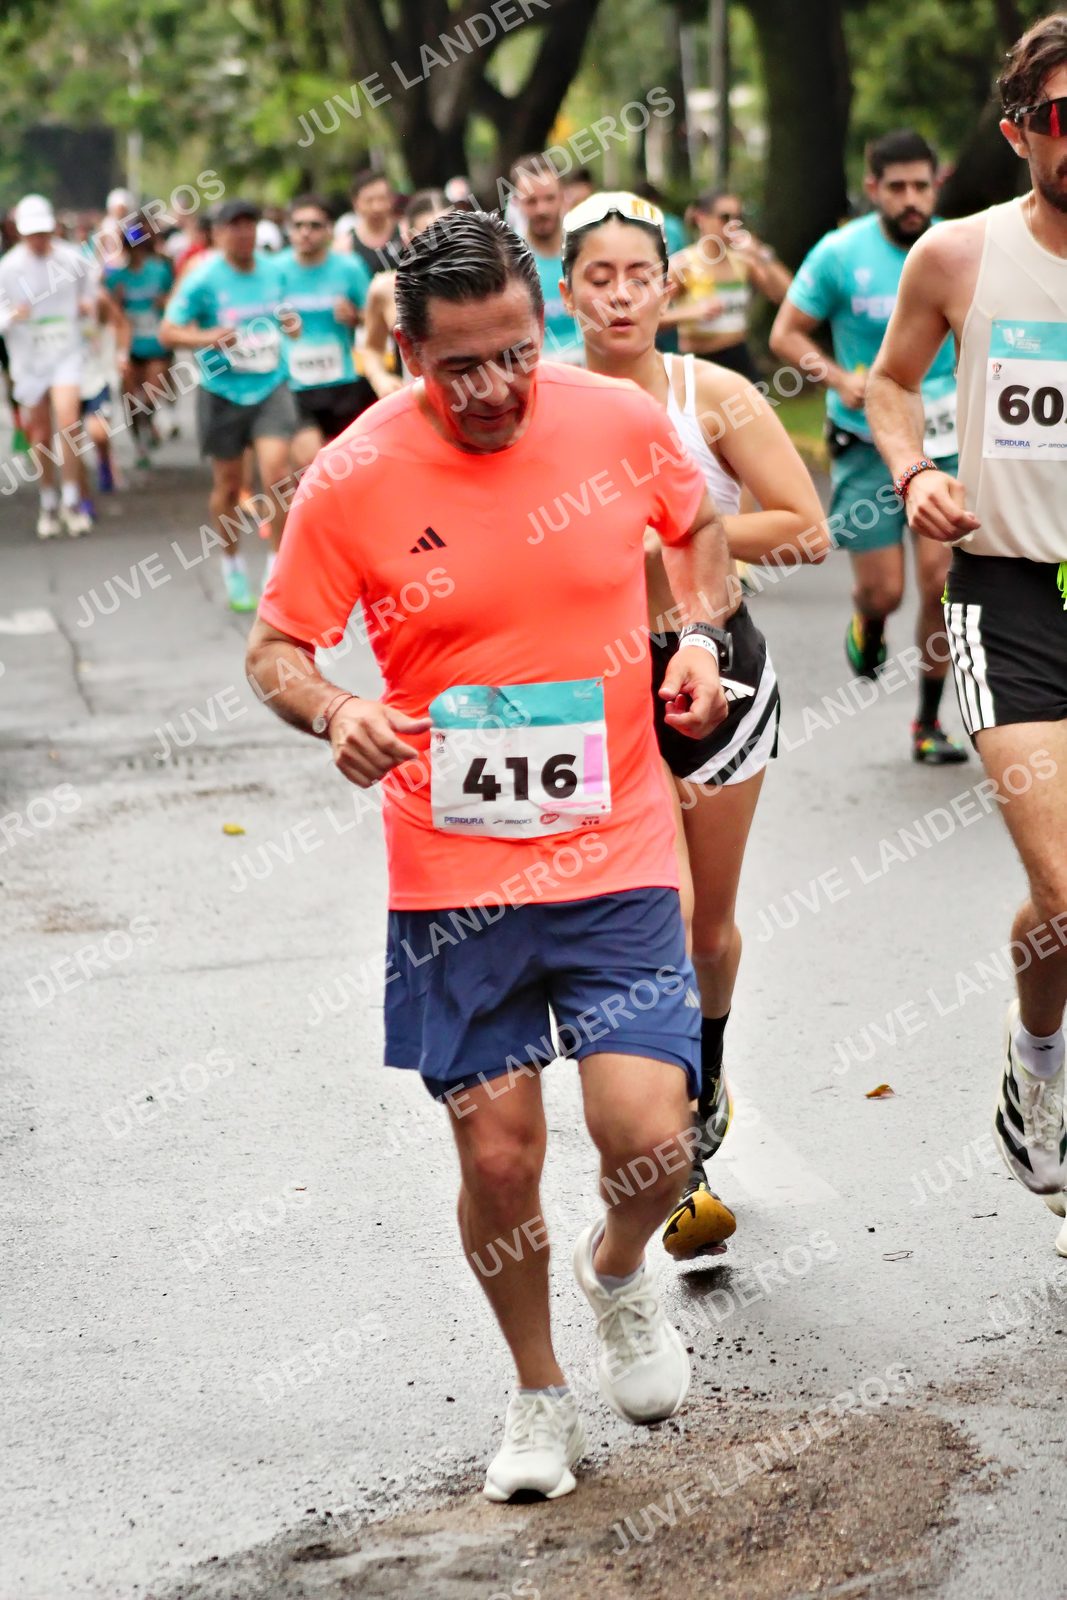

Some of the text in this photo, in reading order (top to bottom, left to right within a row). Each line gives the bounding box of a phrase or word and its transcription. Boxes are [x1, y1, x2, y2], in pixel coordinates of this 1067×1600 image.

[998, 384, 1067, 427] 60
[994, 439, 1031, 448] PERDURA
[463, 754, 578, 801] 416
[444, 816, 485, 825] PERDURA
